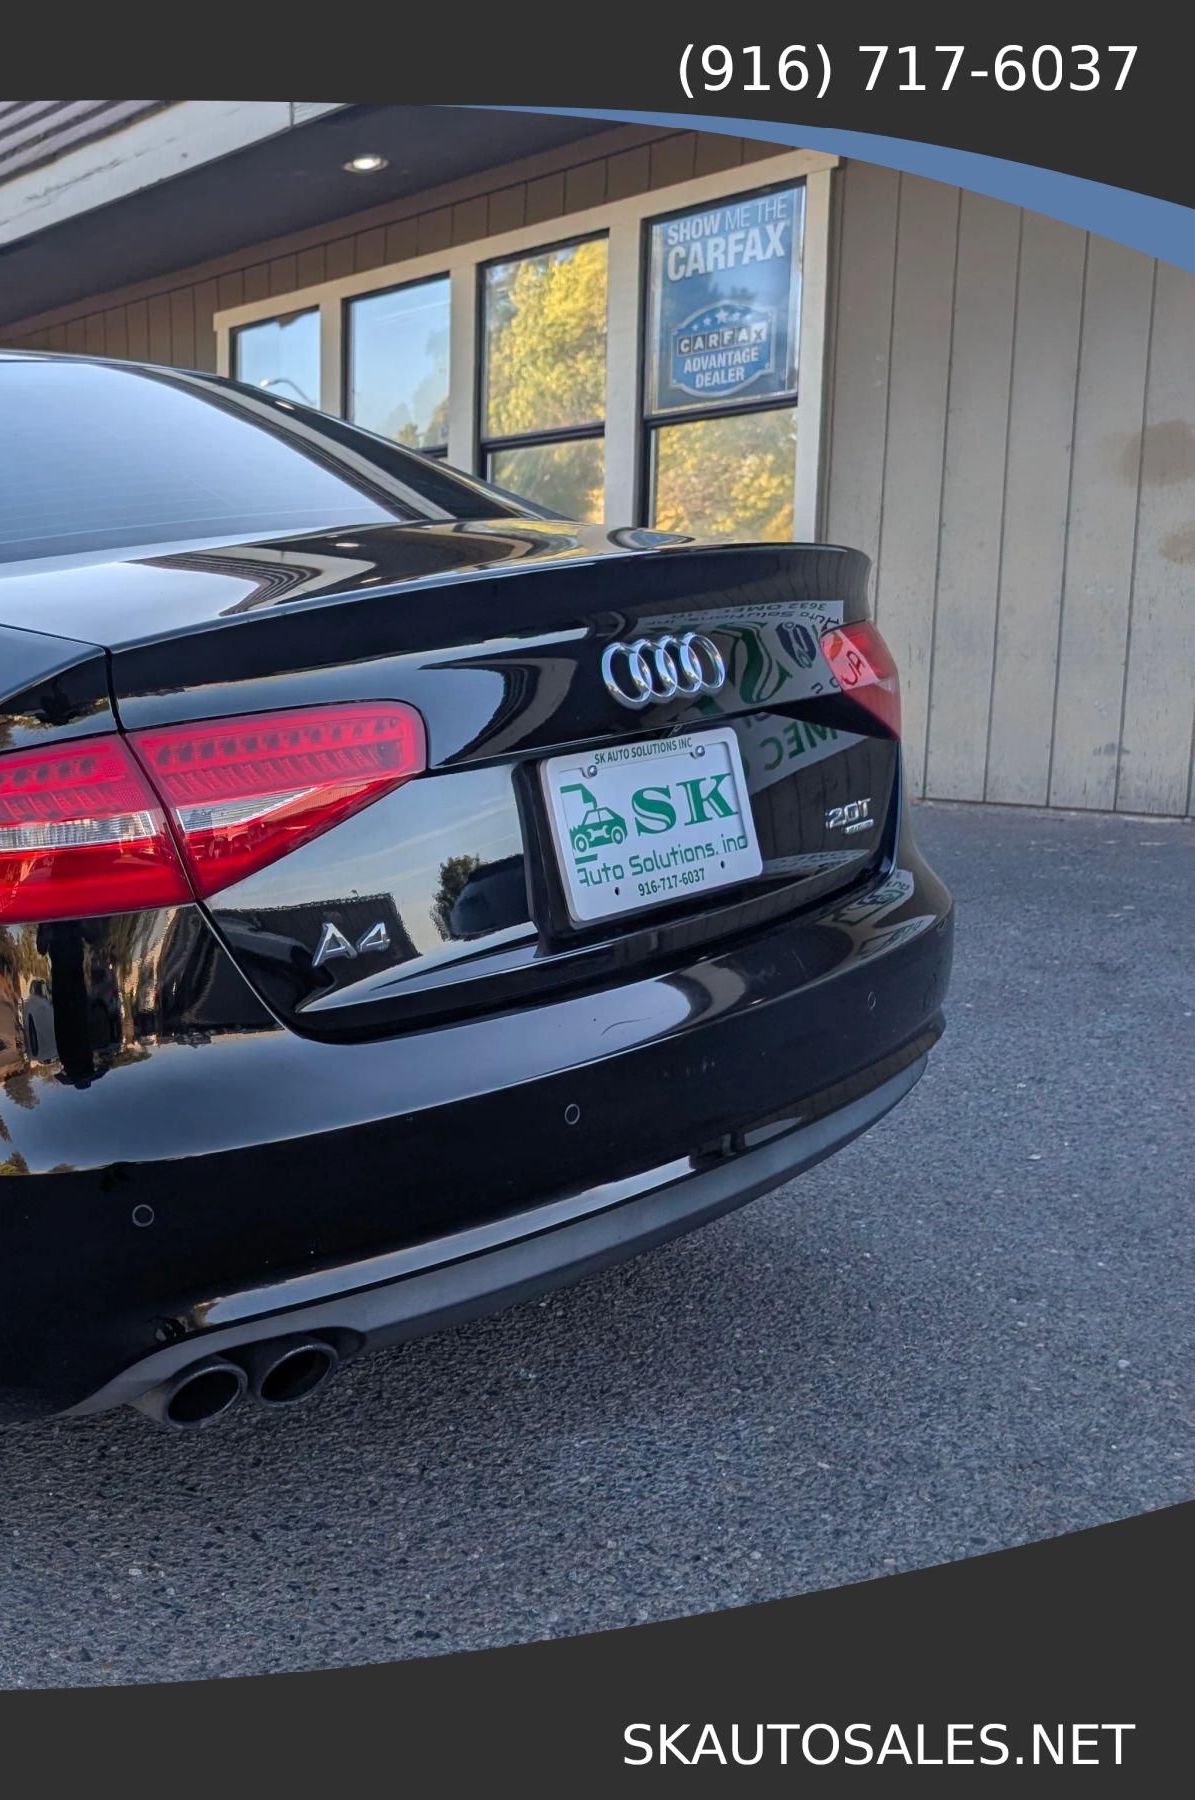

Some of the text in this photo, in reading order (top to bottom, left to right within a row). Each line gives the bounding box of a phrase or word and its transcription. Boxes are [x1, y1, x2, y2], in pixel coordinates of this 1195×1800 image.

[667, 194, 788, 246] SHOW ME THE
[667, 221, 786, 282] CARFAX
[679, 327, 765, 354] CARFAX
[683, 346, 760, 374] ADVANTAGE
[695, 366, 745, 389] DEALER
[594, 737, 693, 765] SK AUTO SOLUTIONS INC
[631, 772, 739, 837] SK
[638, 868, 705, 896] 916-717-6037
[312, 922, 391, 967] A4
